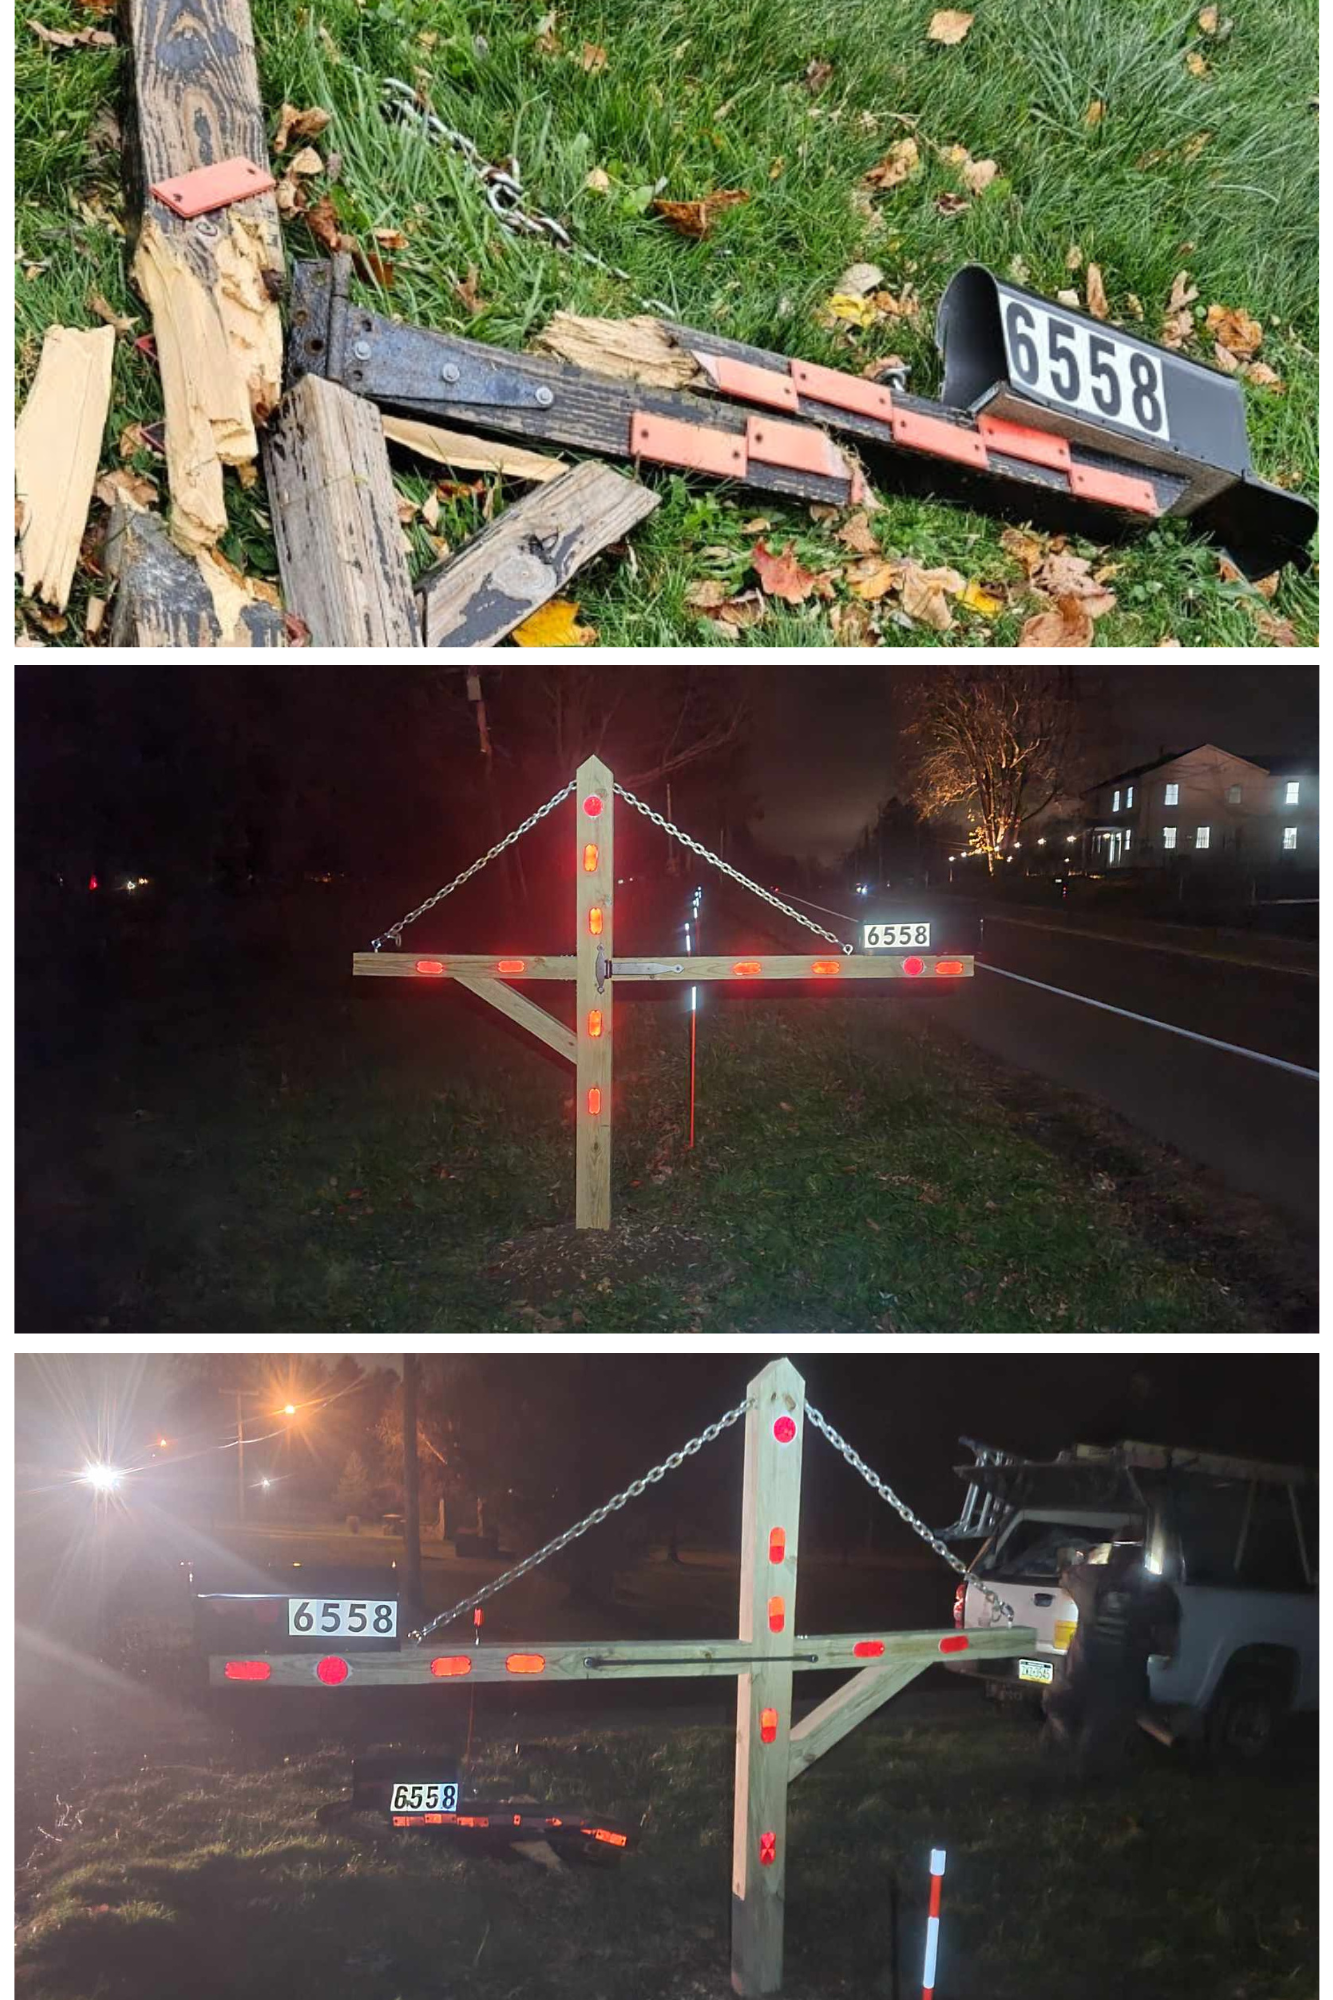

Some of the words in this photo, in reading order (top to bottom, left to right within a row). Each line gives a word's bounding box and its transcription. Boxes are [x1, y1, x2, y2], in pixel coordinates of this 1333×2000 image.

[1006, 301, 1163, 432] 6558
[868, 925, 928, 946] 6558
[294, 1602, 393, 1634] 6558
[394, 1785, 456, 1810] 6558
